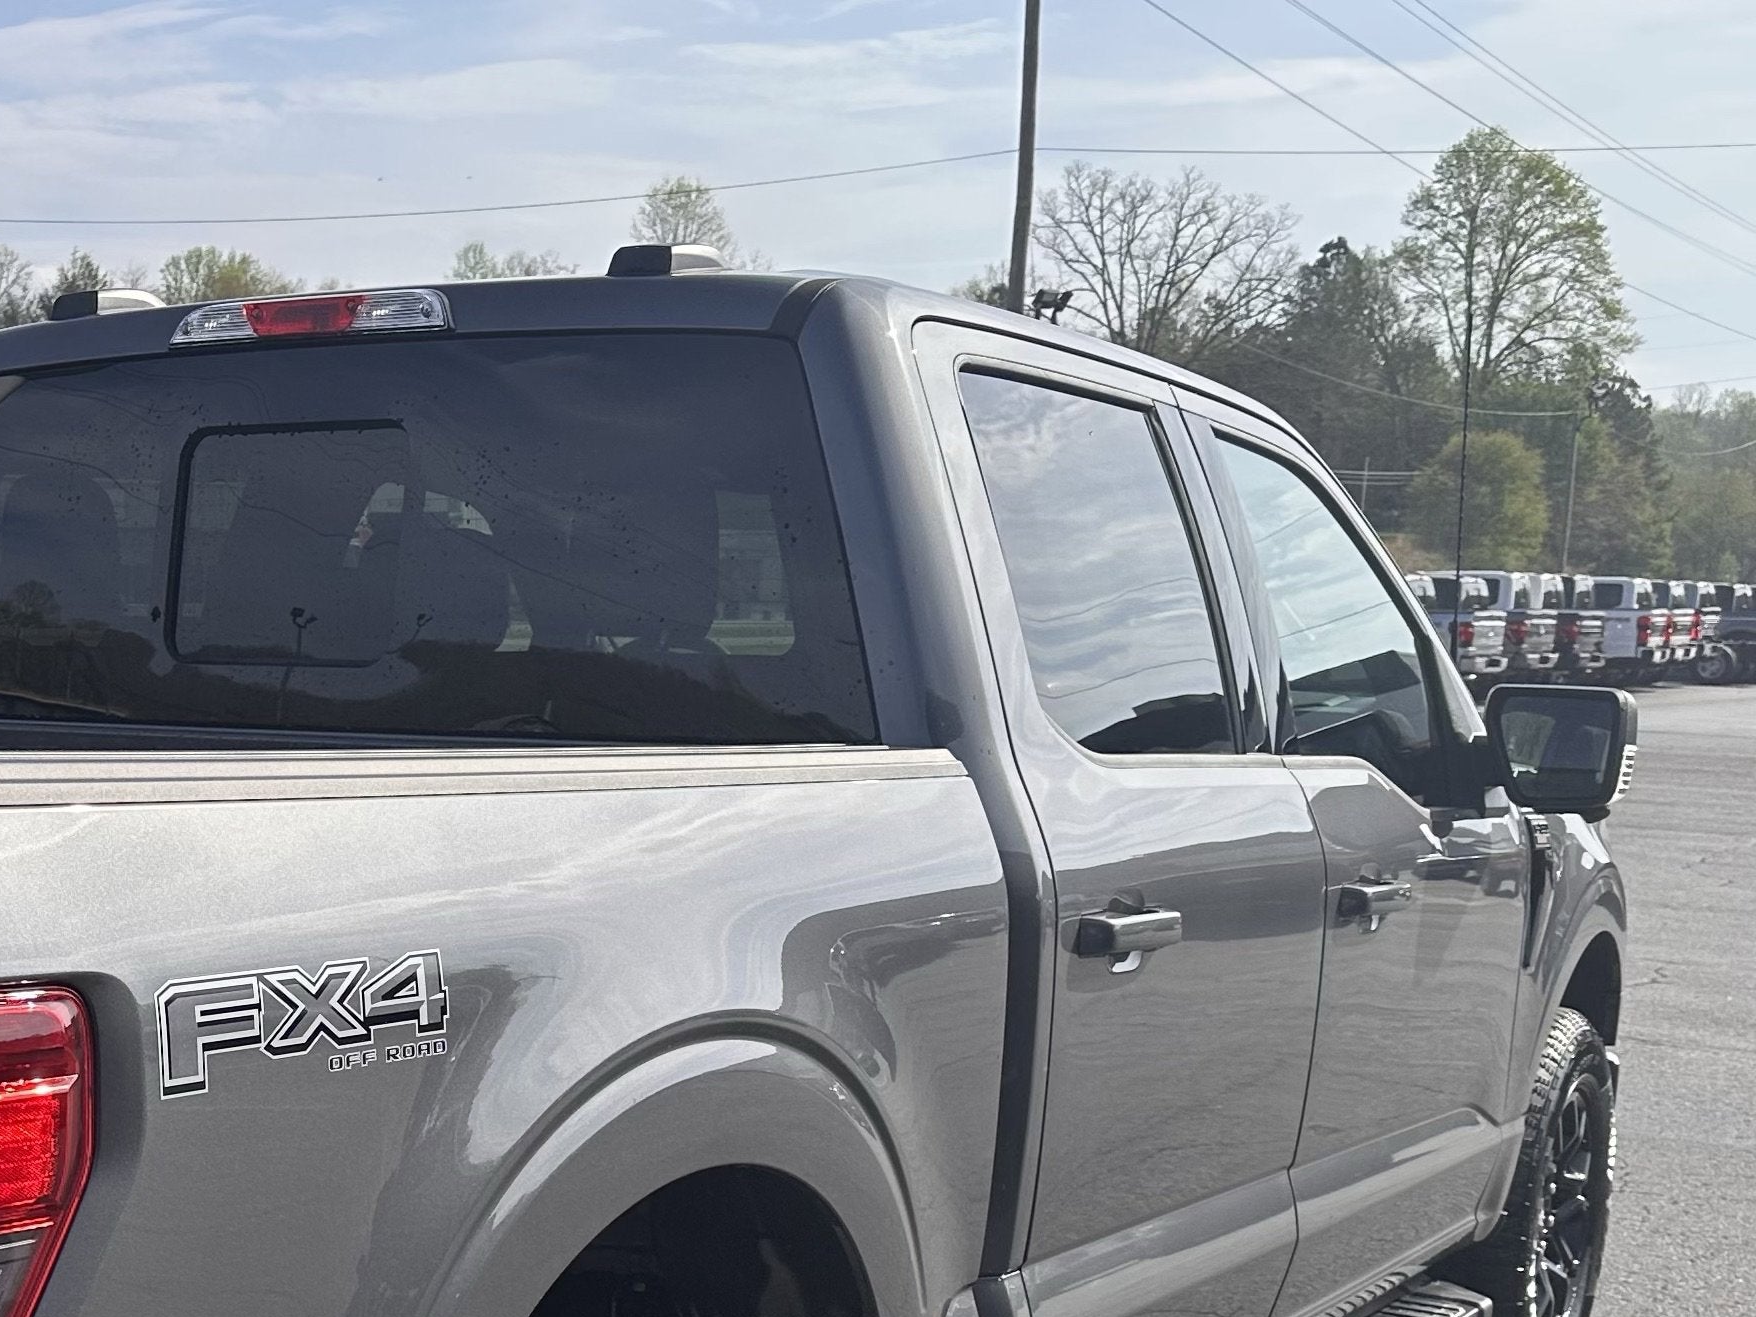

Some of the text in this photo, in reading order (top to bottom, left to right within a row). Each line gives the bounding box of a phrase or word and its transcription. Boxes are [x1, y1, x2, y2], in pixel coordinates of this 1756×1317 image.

[154, 948, 450, 1100] FX4
[328, 1038, 448, 1072] OFF ROAD
